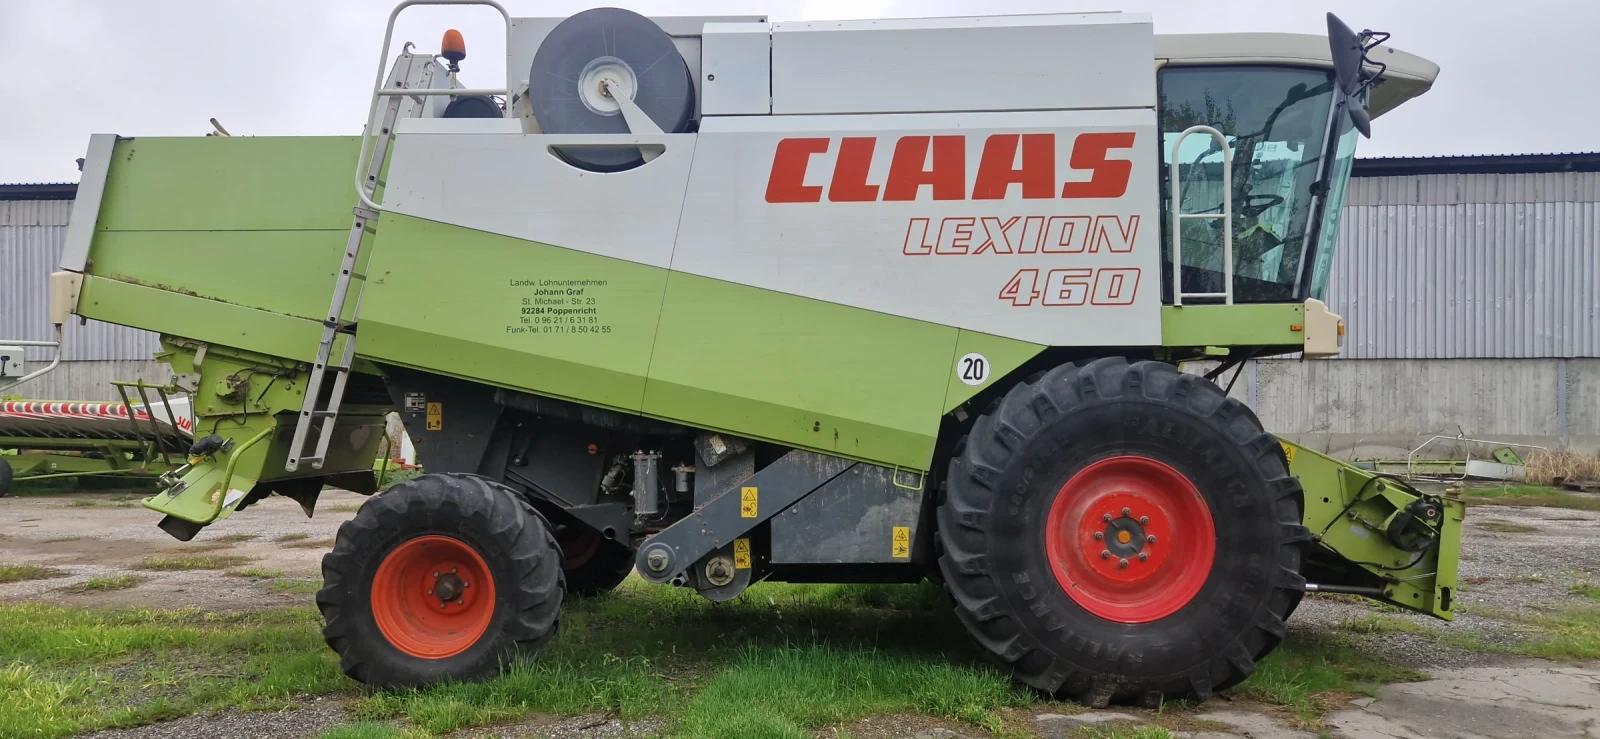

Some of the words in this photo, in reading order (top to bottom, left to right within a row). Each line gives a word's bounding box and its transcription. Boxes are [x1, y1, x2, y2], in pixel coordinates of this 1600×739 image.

[765, 132, 1136, 203] CLAAS
[902, 215, 1140, 256] LEXION
[509, 279, 537, 287] Landw.
[539, 279, 608, 287] Lohnunternehmen
[998, 267, 1141, 307] 460
[533, 288, 564, 296] Johann
[566, 288, 584, 296] Graf
[521, 297, 532, 305] St.
[534, 297, 564, 305] Michael
[571, 297, 583, 305] Str.
[585, 297, 596, 305] 23
[521, 307, 545, 315] 92284
[547, 307, 597, 316] Poppenricht
[519, 316, 533, 324] Tel.
[534, 316, 541, 324] 0
[541, 316, 552, 324] 96
[553, 316, 563, 324] 21
[569, 316, 575, 324] 6
[576, 316, 586, 324] 31
[588, 316, 598, 324] 81
[506, 325, 541, 334] Funk-Tel.
[543, 325, 552, 334] 01
[554, 325, 564, 334] 71
[571, 325, 577, 334] 8
[578, 325, 588, 334] 50
[589, 325, 600, 334] 42
[601, 325, 612, 334] 55
[962, 358, 984, 381] 20
[1010, 567, 1124, 662] ALLIANCE
